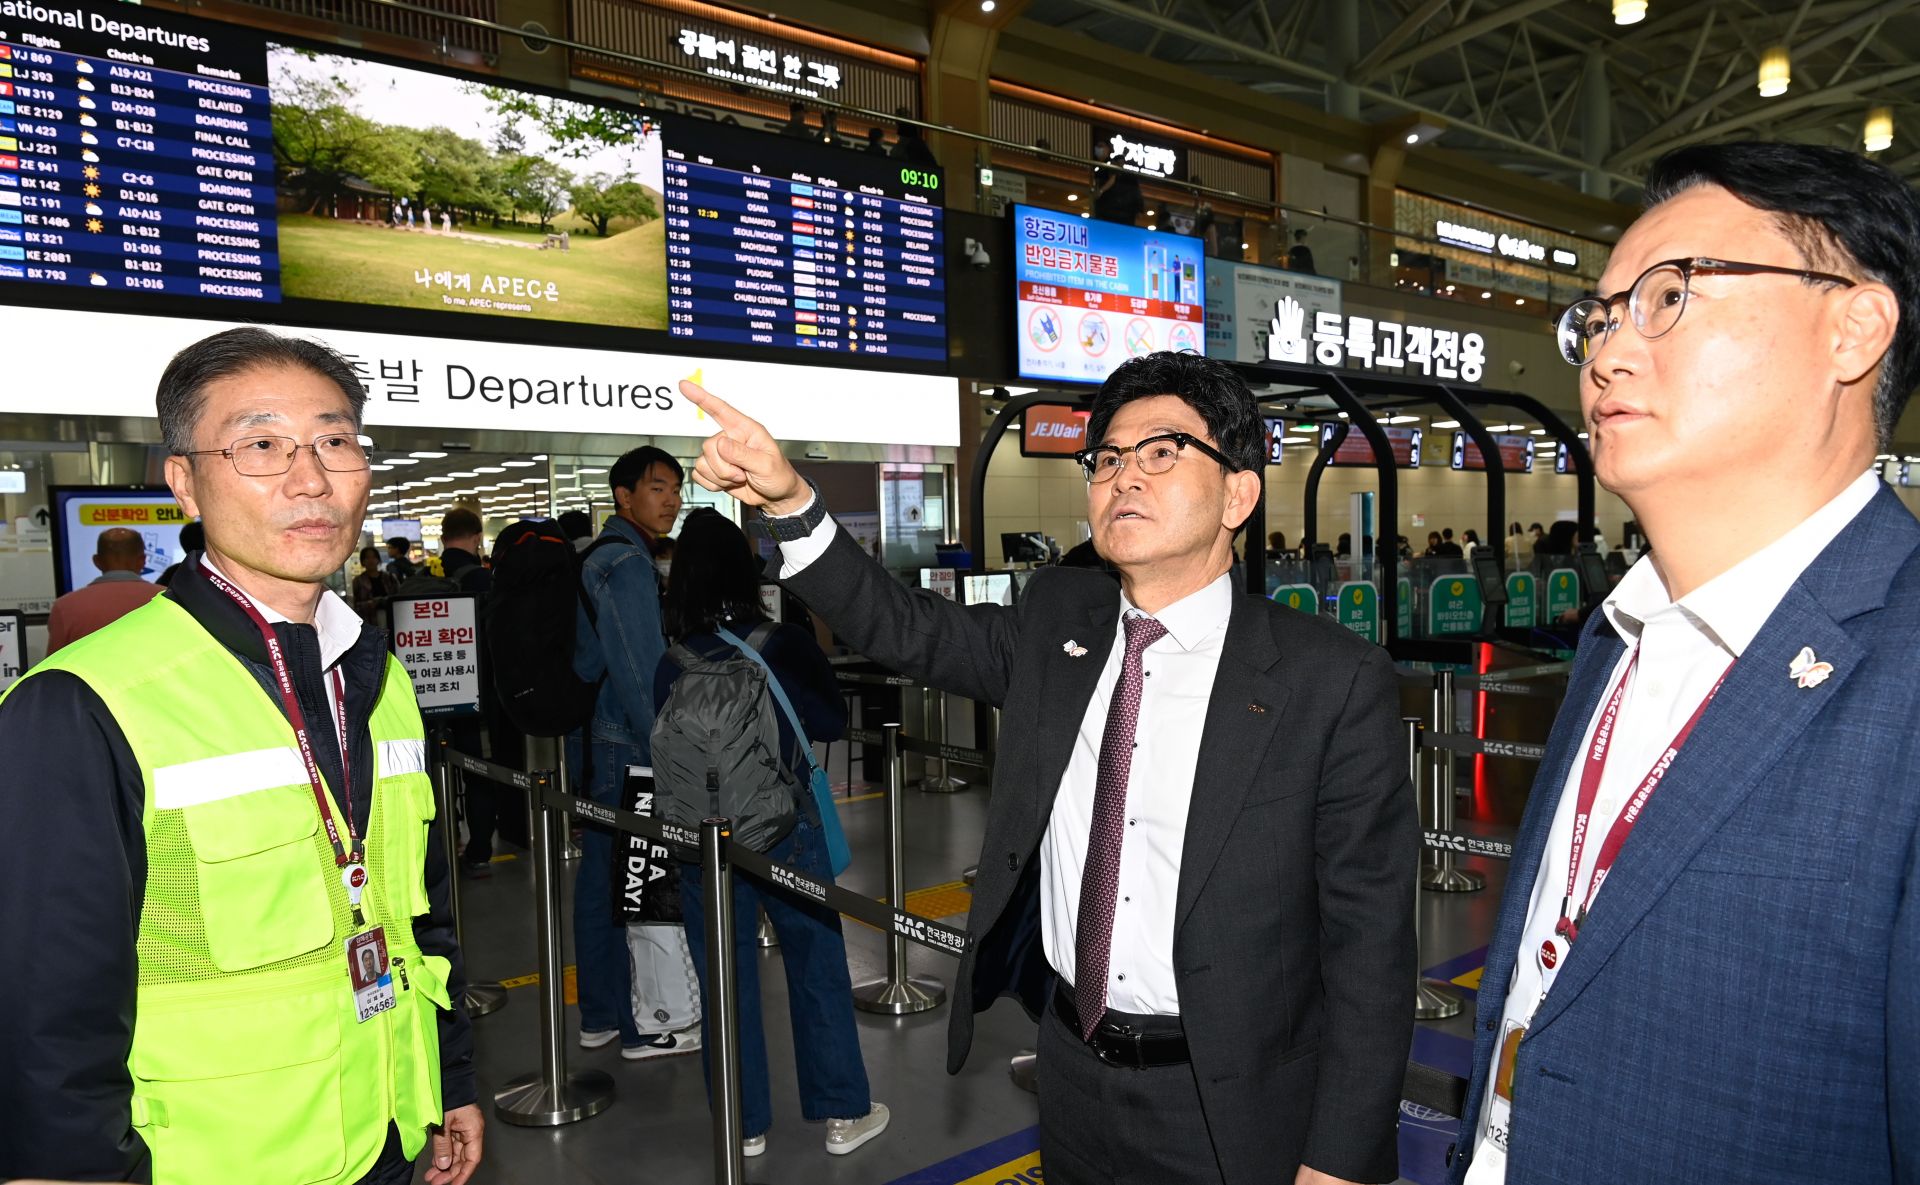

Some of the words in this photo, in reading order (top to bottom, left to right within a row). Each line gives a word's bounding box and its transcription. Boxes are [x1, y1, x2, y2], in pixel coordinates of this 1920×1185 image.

[0, 1, 84, 29] ational
[90, 13, 210, 52] Departures
[22, 33, 61, 49] Flights
[197, 64, 241, 80] Remarks
[12, 49, 28, 61] VJ
[110, 66, 153, 82] A19-A21
[188, 79, 252, 99] PROCESSING
[14, 68, 29, 79] LJ
[199, 98, 243, 113] DELAYED
[33, 89, 55, 100] 319
[195, 114, 248, 131] BOARDING
[16, 105, 31, 115] KE
[34, 107, 63, 120] 2129
[116, 119, 154, 134] B1-B12
[195, 131, 224, 145] FINAL
[225, 136, 250, 148] CALL
[17, 123, 33, 134] VN
[35, 125, 57, 137] 423
[192, 148, 255, 165] PROCESSING
[19, 141, 34, 153] LJ
[36, 144, 57, 155] 221
[196, 165, 223, 178] GATE
[224, 169, 252, 182] OPEN
[20, 159, 35, 170] ZE
[37, 161, 58, 173] 941
[122, 172, 154, 185] C2-C6
[199, 182, 251, 198] BOARDING
[901, 168, 938, 189] 09:10
[21, 177, 37, 188] BX
[39, 180, 60, 191] 142
[120, 189, 158, 204] D1-D16
[198, 199, 225, 212] GATE
[226, 203, 254, 215] OPEN
[22, 195, 38, 206] CI
[40, 198, 61, 209] 191
[119, 206, 161, 221] A10-A15
[196, 215, 259, 232] PROCESSING
[24, 214, 38, 225] KE
[123, 224, 160, 238] B1-B12
[197, 232, 260, 249] PROCESSING
[1024, 216, 1087, 247] 항공기내
[25, 232, 40, 242] BX
[42, 234, 63, 245] 321
[123, 242, 162, 255] D1-D16
[198, 249, 261, 265] PROCESSING
[1025, 244, 1118, 277] 반입금지물품
[26, 250, 41, 260] KE
[125, 259, 162, 272] B1-B12
[199, 266, 262, 282] PROCESSING
[1025, 269, 1066, 283] PROHIBITED
[1068, 275, 1084, 285] ITEM
[1086, 278, 1094, 287] IN
[1095, 279, 1108, 289] THE
[1109, 281, 1129, 292] CABIN
[27, 268, 43, 278] BX
[45, 269, 67, 281] 793
[125, 277, 164, 289] D1-D16
[200, 283, 263, 298] PROCESSING
[414, 268, 471, 292] 나에게
[481, 274, 559, 302] APEC은
[443, 295, 452, 304] To
[453, 297, 467, 307] me,
[469, 298, 491, 308] APEC
[493, 301, 532, 312] represents
[1313, 311, 1486, 383] 등록고객전용
[446, 363, 674, 410] Departures
[1030, 421, 1083, 440] JEJUair
[92, 507, 149, 522] 신분확인
[156, 507, 184, 522] 안내
[209, 575, 227, 591] KAC
[413, 601, 449, 619] 본인
[268, 638, 282, 660] KAC
[396, 630, 432, 648] 여권
[438, 627, 473, 645] 확인
[3, 663, 19, 678] in
[405, 653, 429, 664] 위조,
[433, 650, 453, 661] 도용
[456, 650, 466, 660] 등
[421, 667, 441, 678] 여권
[445, 665, 475, 676] 사용시
[415, 683, 436, 694] 법적
[439, 681, 460, 692] 조치
[1608, 687, 1623, 716] KAC
[297, 729, 310, 751] KAC
[1484, 741, 1514, 755] KAC
[1652, 747, 1678, 779] KAC
[575, 800, 593, 817] KAC
[662, 824, 684, 842] KAC
[1424, 832, 1466, 851] KAC
[1467, 838, 1512, 854] 한국공항공
[1574, 813, 1588, 844] KAC
[623, 855, 647, 912] DAY!
[771, 865, 795, 889] KAC
[795, 876, 826, 896] 한국공항공사
[894, 912, 926, 941] KAC
[1541, 948, 1556, 962] KAC
